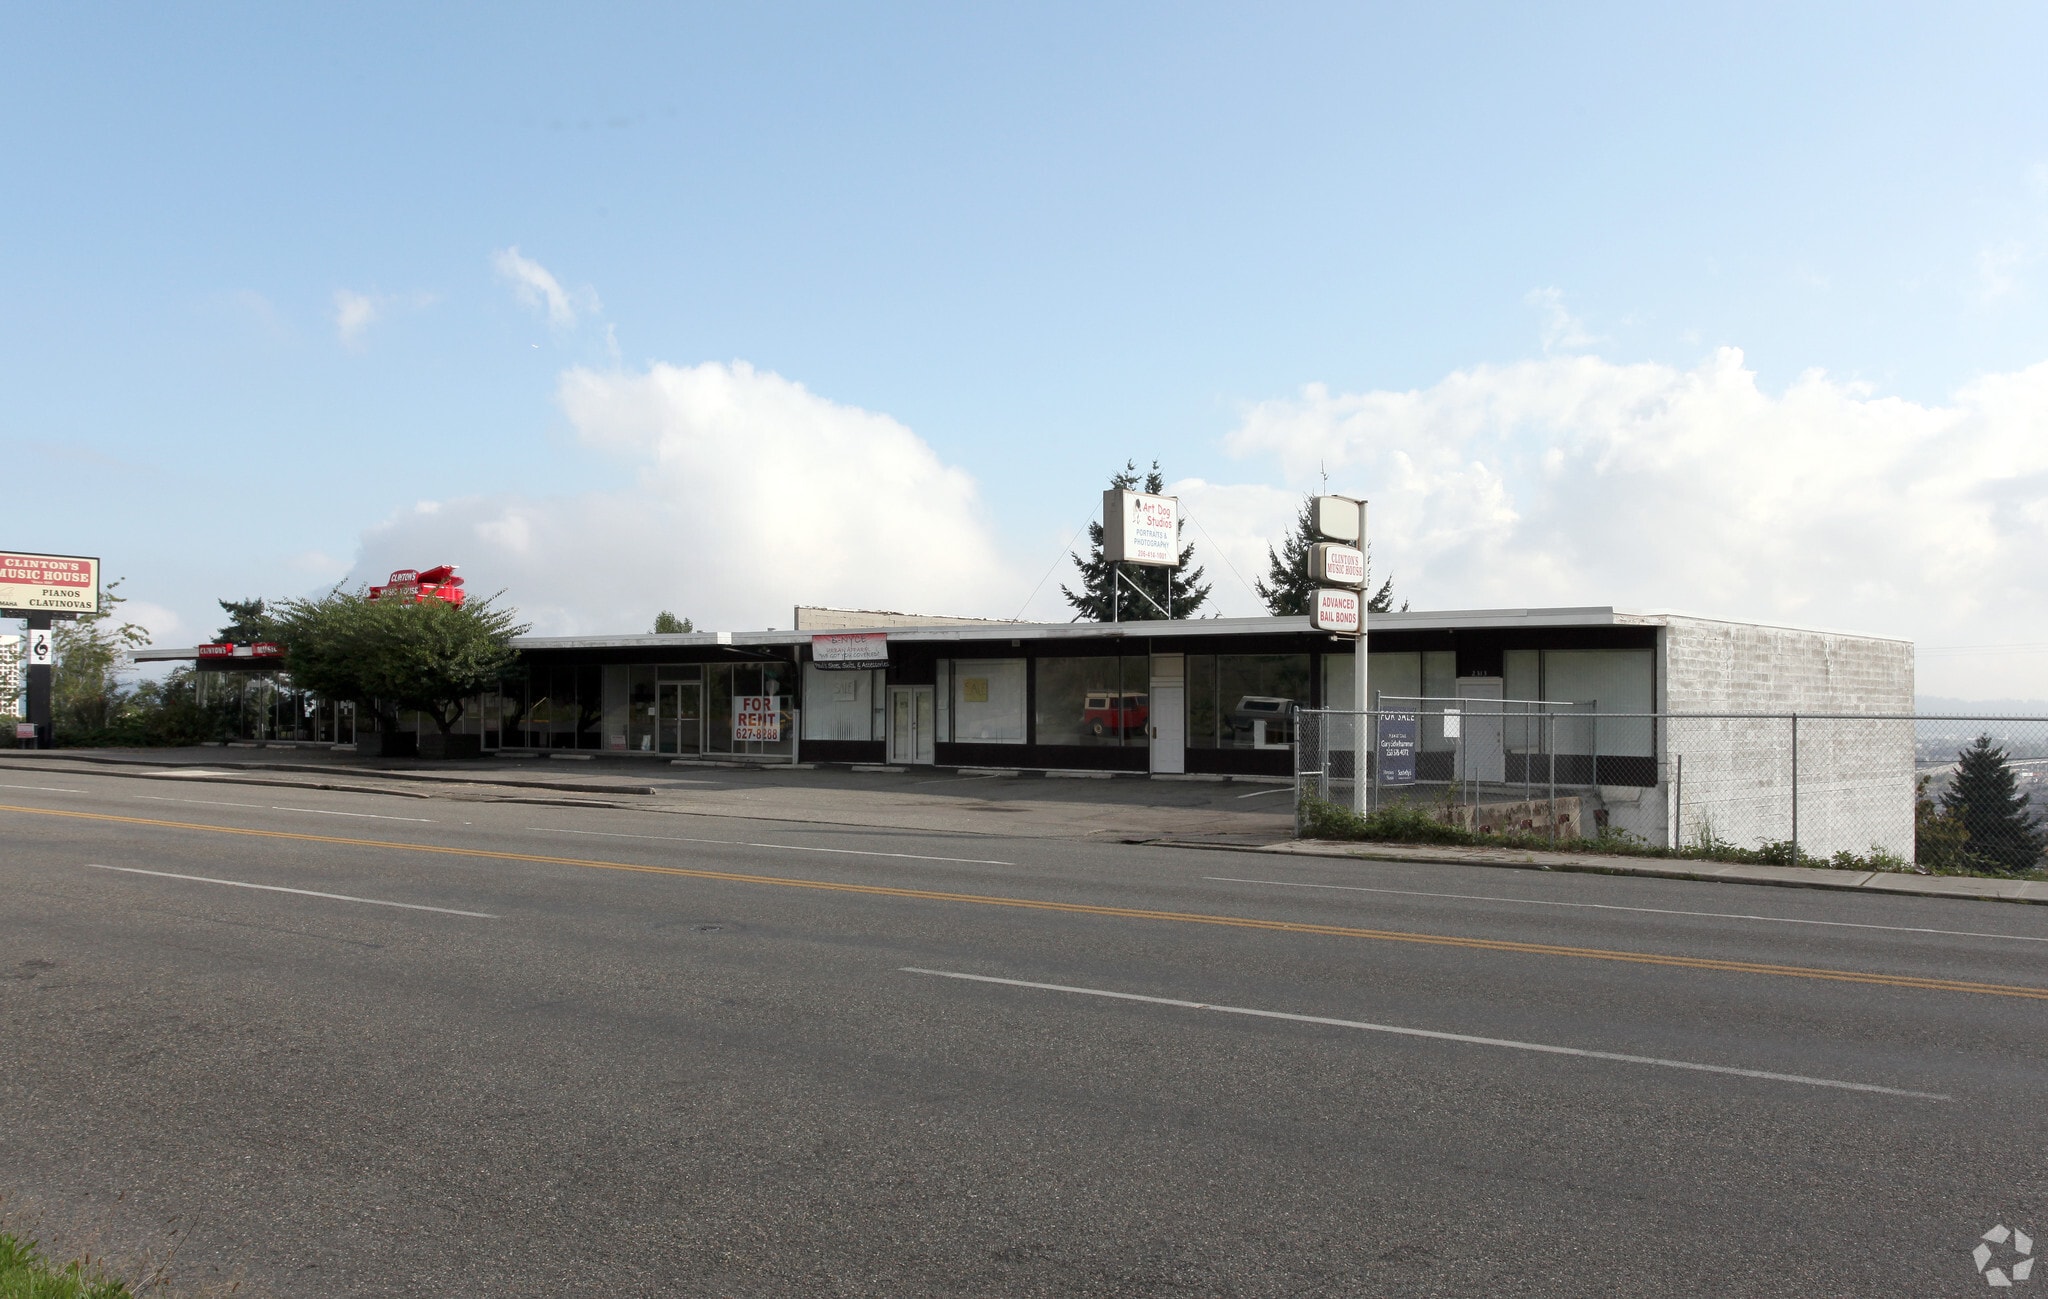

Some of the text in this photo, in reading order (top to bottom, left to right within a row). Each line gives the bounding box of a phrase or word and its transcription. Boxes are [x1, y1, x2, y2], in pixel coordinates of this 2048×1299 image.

[1143, 503, 1171, 519] Art Dog
[1147, 515, 1172, 528] Studios
[1136, 529, 1163, 539] PORTRAITS
[1134, 538, 1170, 548] PHOTOGRAPHY
[5, 558, 79, 571] CLINTON'S
[1331, 553, 1359, 566] CLINTON'S
[1327, 563, 1363, 577] MUSIC HOUSE
[43, 571, 89, 583] HOUSE
[391, 572, 416, 582] CLINTON'S
[42, 589, 80, 598] PIANOS
[29, 599, 92, 608] CLAVINOVAS
[1322, 597, 1354, 609] ADVANCED
[1320, 611, 1356, 623] BAIL BONDS
[743, 697, 772, 711] FOR
[738, 713, 776, 726] RENT
